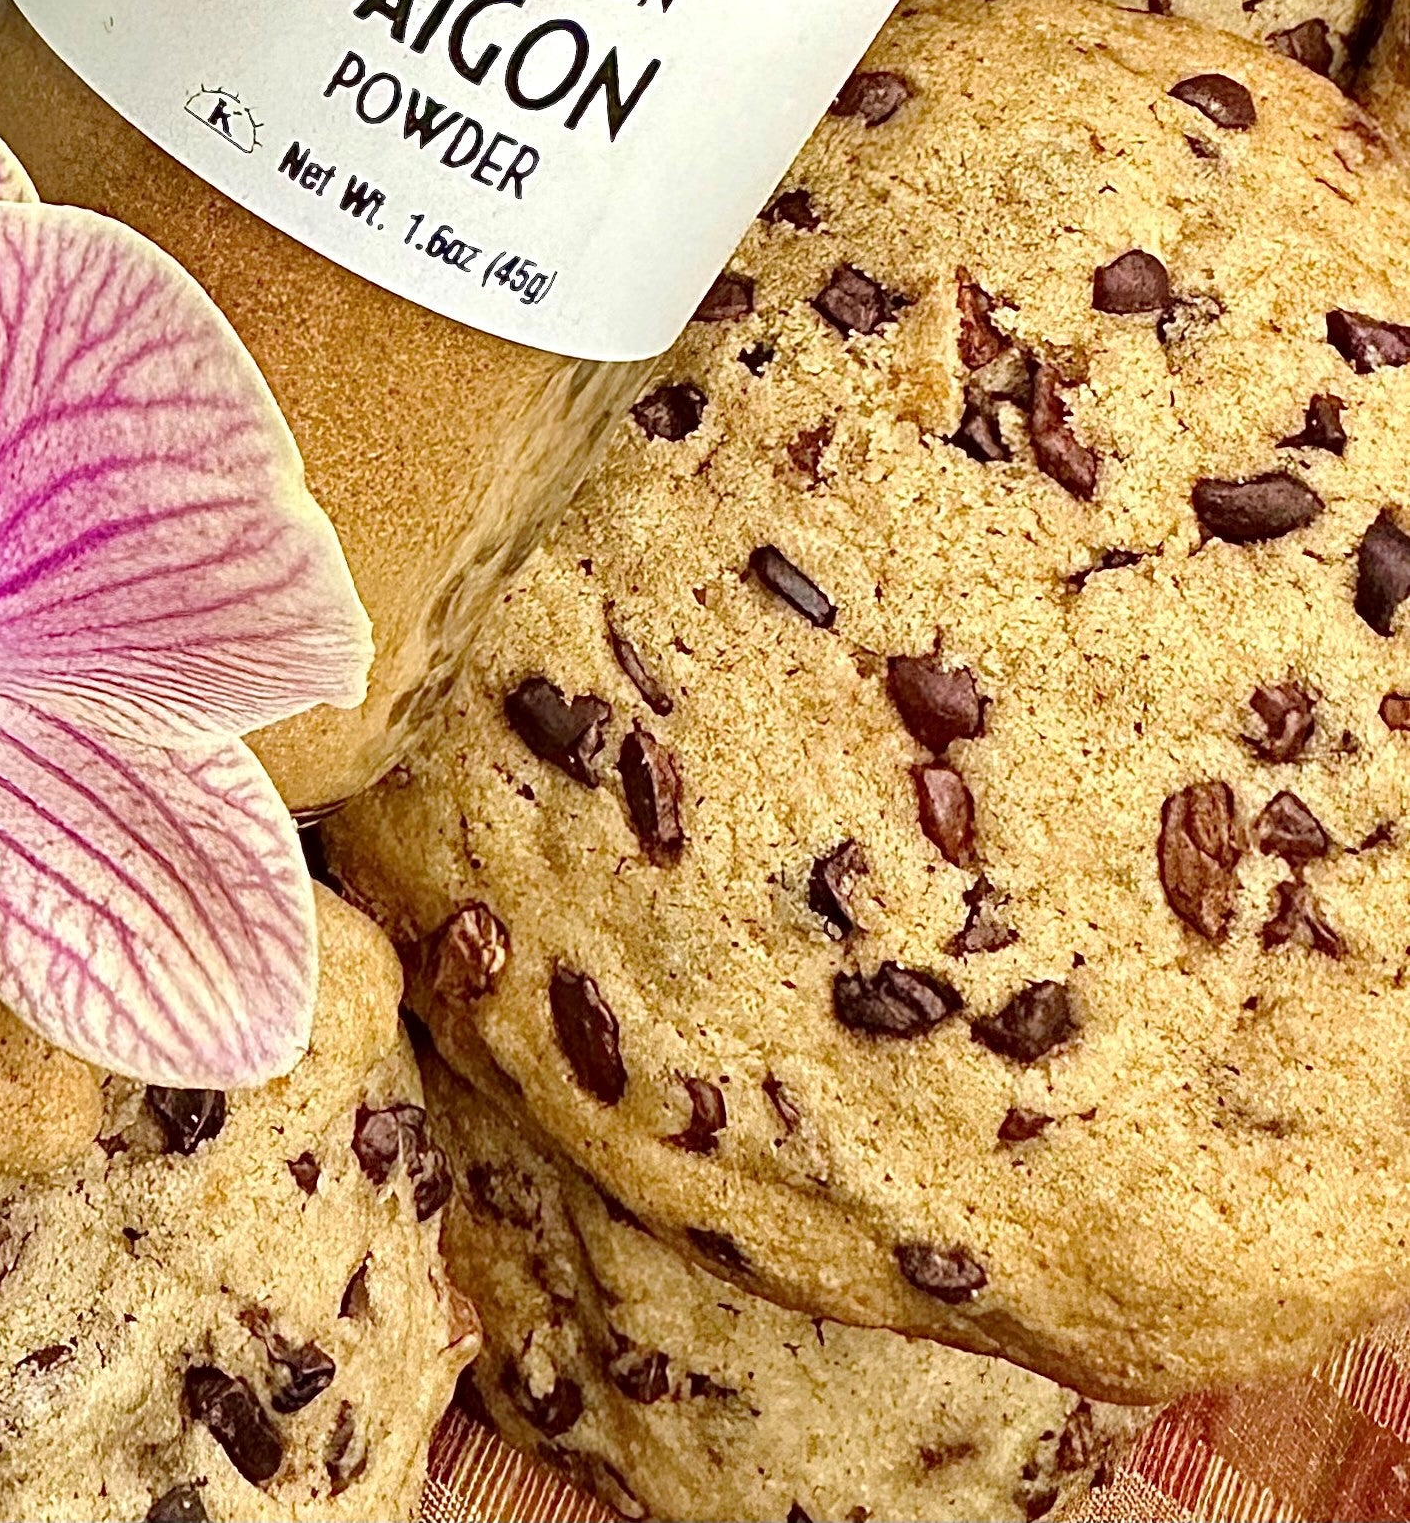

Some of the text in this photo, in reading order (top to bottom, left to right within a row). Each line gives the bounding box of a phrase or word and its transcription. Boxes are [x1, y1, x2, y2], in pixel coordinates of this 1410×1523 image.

[323, 51, 540, 199] POWDER
[278, 141, 557, 304] Net Wt. 1.6oz (45g)
